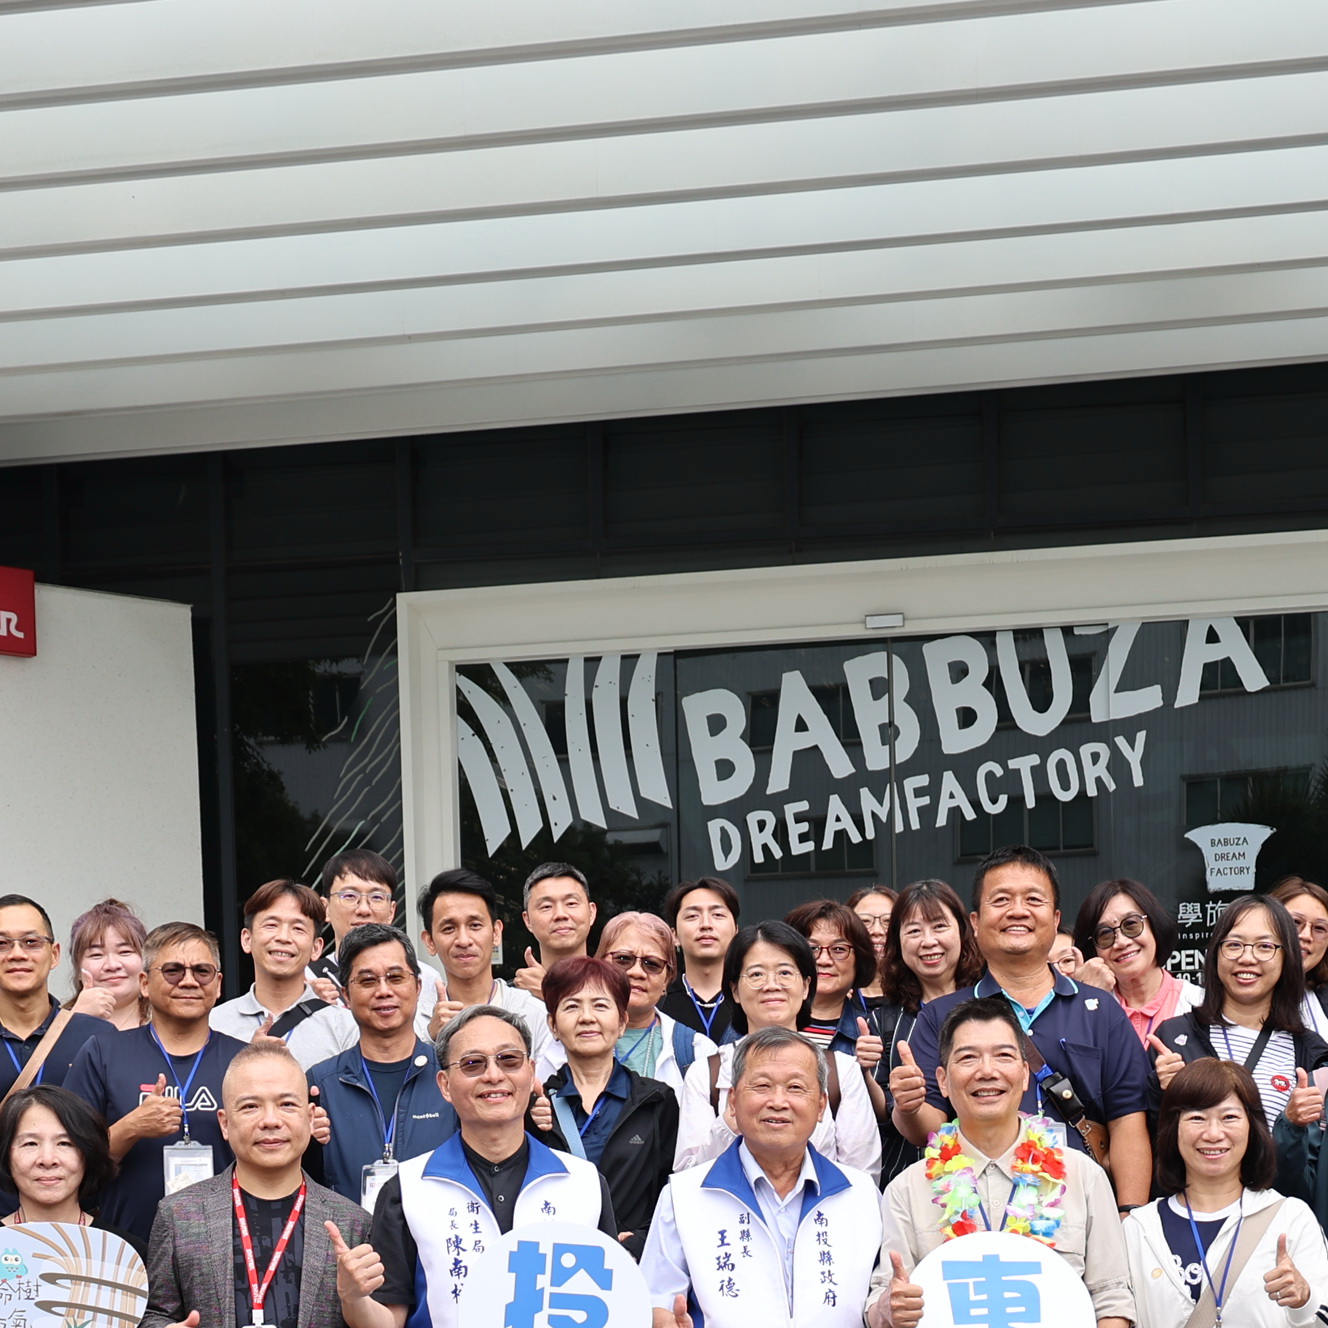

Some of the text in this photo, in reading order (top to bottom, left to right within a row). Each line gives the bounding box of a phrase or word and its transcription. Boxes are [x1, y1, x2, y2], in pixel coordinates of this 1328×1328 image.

[681, 617, 1270, 807] BABBUZA
[706, 731, 1150, 872] DREAMFACTORY
[1210, 837, 1249, 848] BABUZA
[1214, 852, 1246, 862] DREAM
[1210, 866, 1251, 876] FACTORY
[1163, 949, 1208, 971] PEN
[448, 1207, 459, 1230] 局長
[467, 1200, 485, 1254] 衛生局
[738, 1212, 753, 1259] 副縣長
[716, 1230, 740, 1299] 王瑞德
[814, 1210, 838, 1308] 南投縣政府
